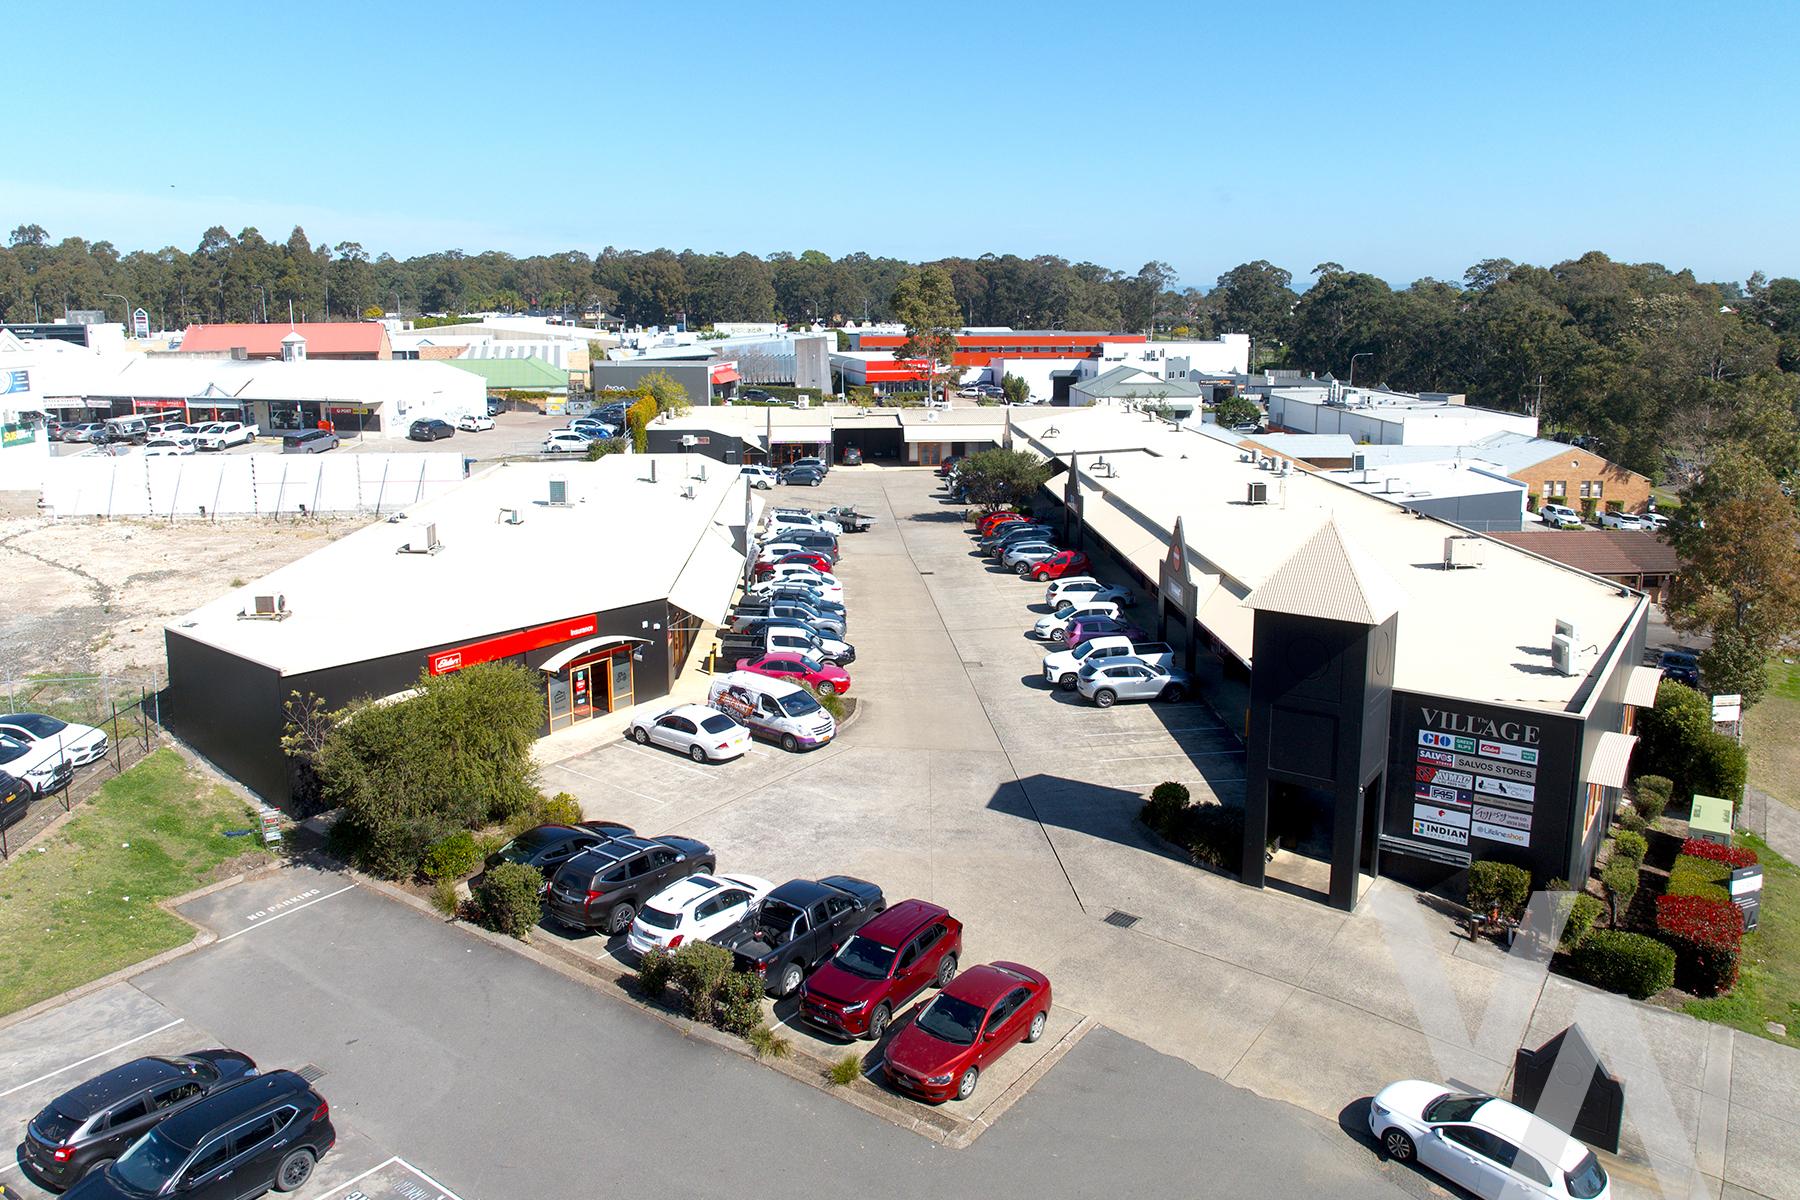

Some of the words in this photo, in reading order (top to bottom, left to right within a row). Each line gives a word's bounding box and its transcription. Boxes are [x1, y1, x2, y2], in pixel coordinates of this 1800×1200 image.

[570, 625, 594, 637] Insurance
[1421, 706, 1540, 745] VILLAGE
[1419, 750, 1452, 762] SALVOS
[1458, 759, 1493, 772] SALVOS
[1496, 765, 1532, 778] STORES
[1433, 789, 1454, 800] F45
[1426, 824, 1467, 840] INDIAN
[246, 910, 267, 921] NO
[267, 888, 321, 912] PARKING
